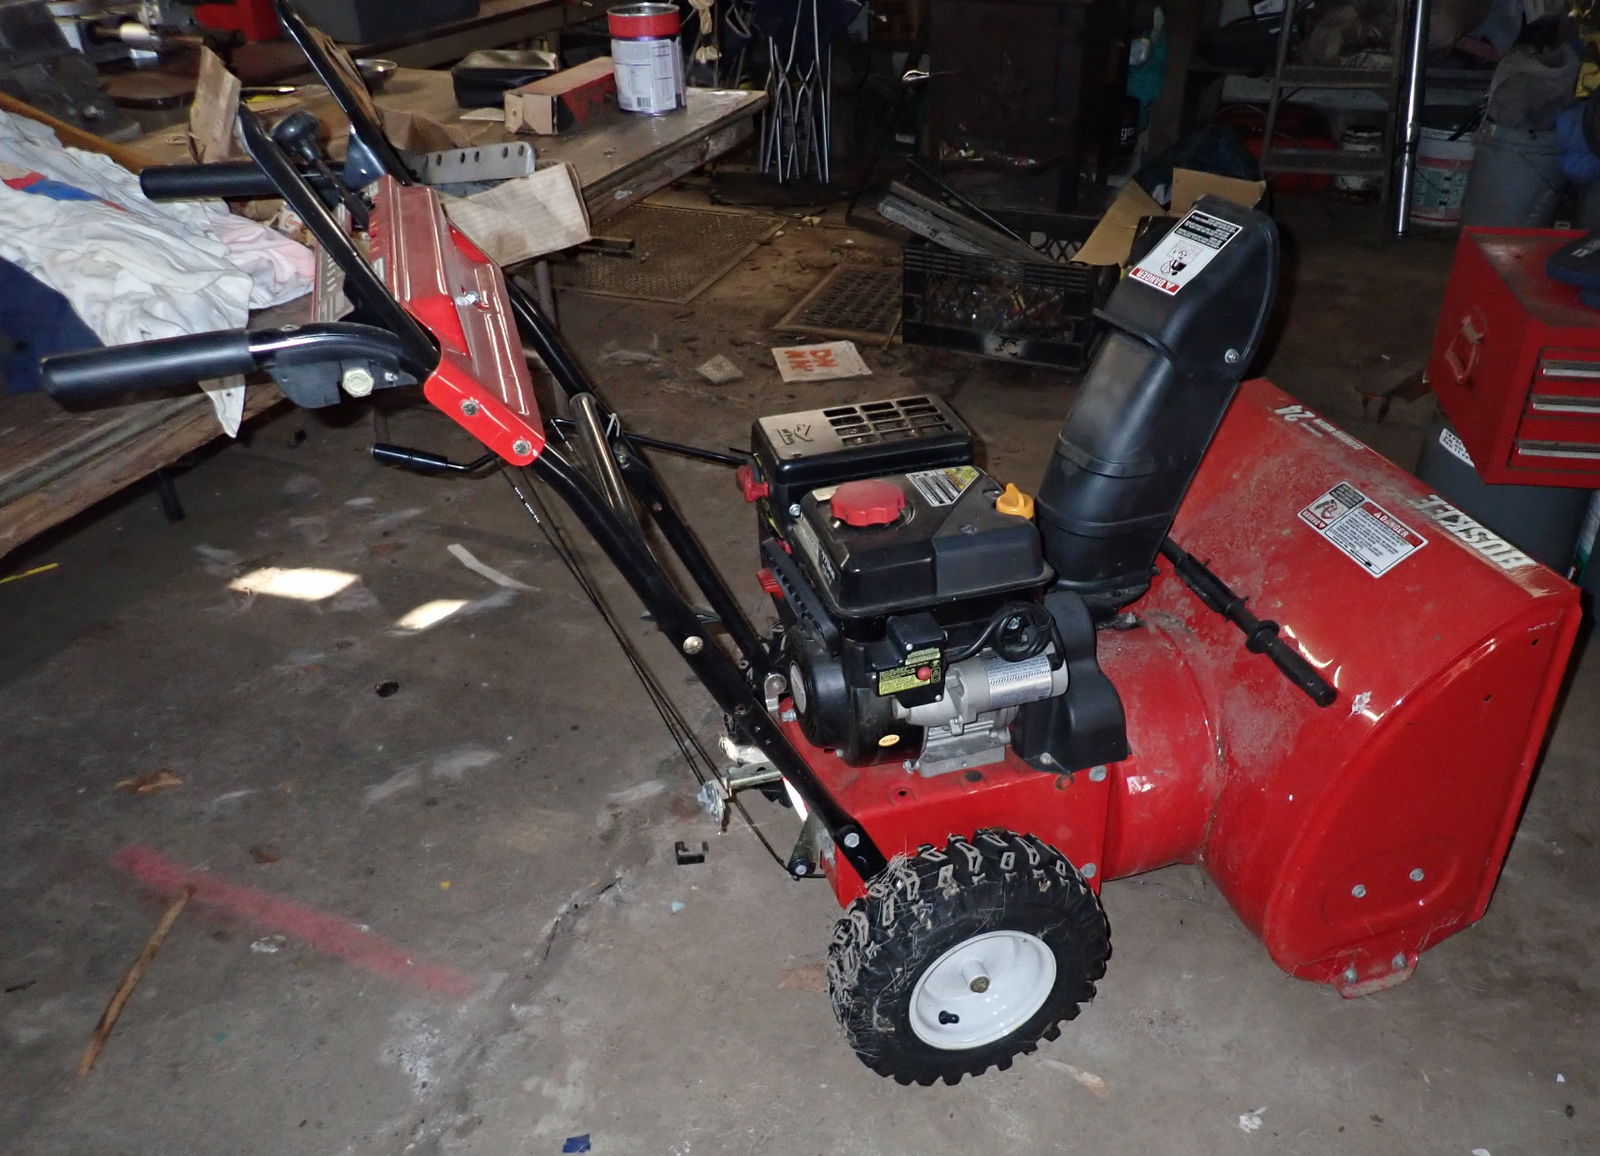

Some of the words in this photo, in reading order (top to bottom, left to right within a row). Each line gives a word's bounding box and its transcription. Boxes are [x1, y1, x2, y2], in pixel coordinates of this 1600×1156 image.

[1136, 269, 1168, 287] DANGER
[1273, 404, 1316, 422] 24
[1415, 493, 1538, 570] HUSKEE
